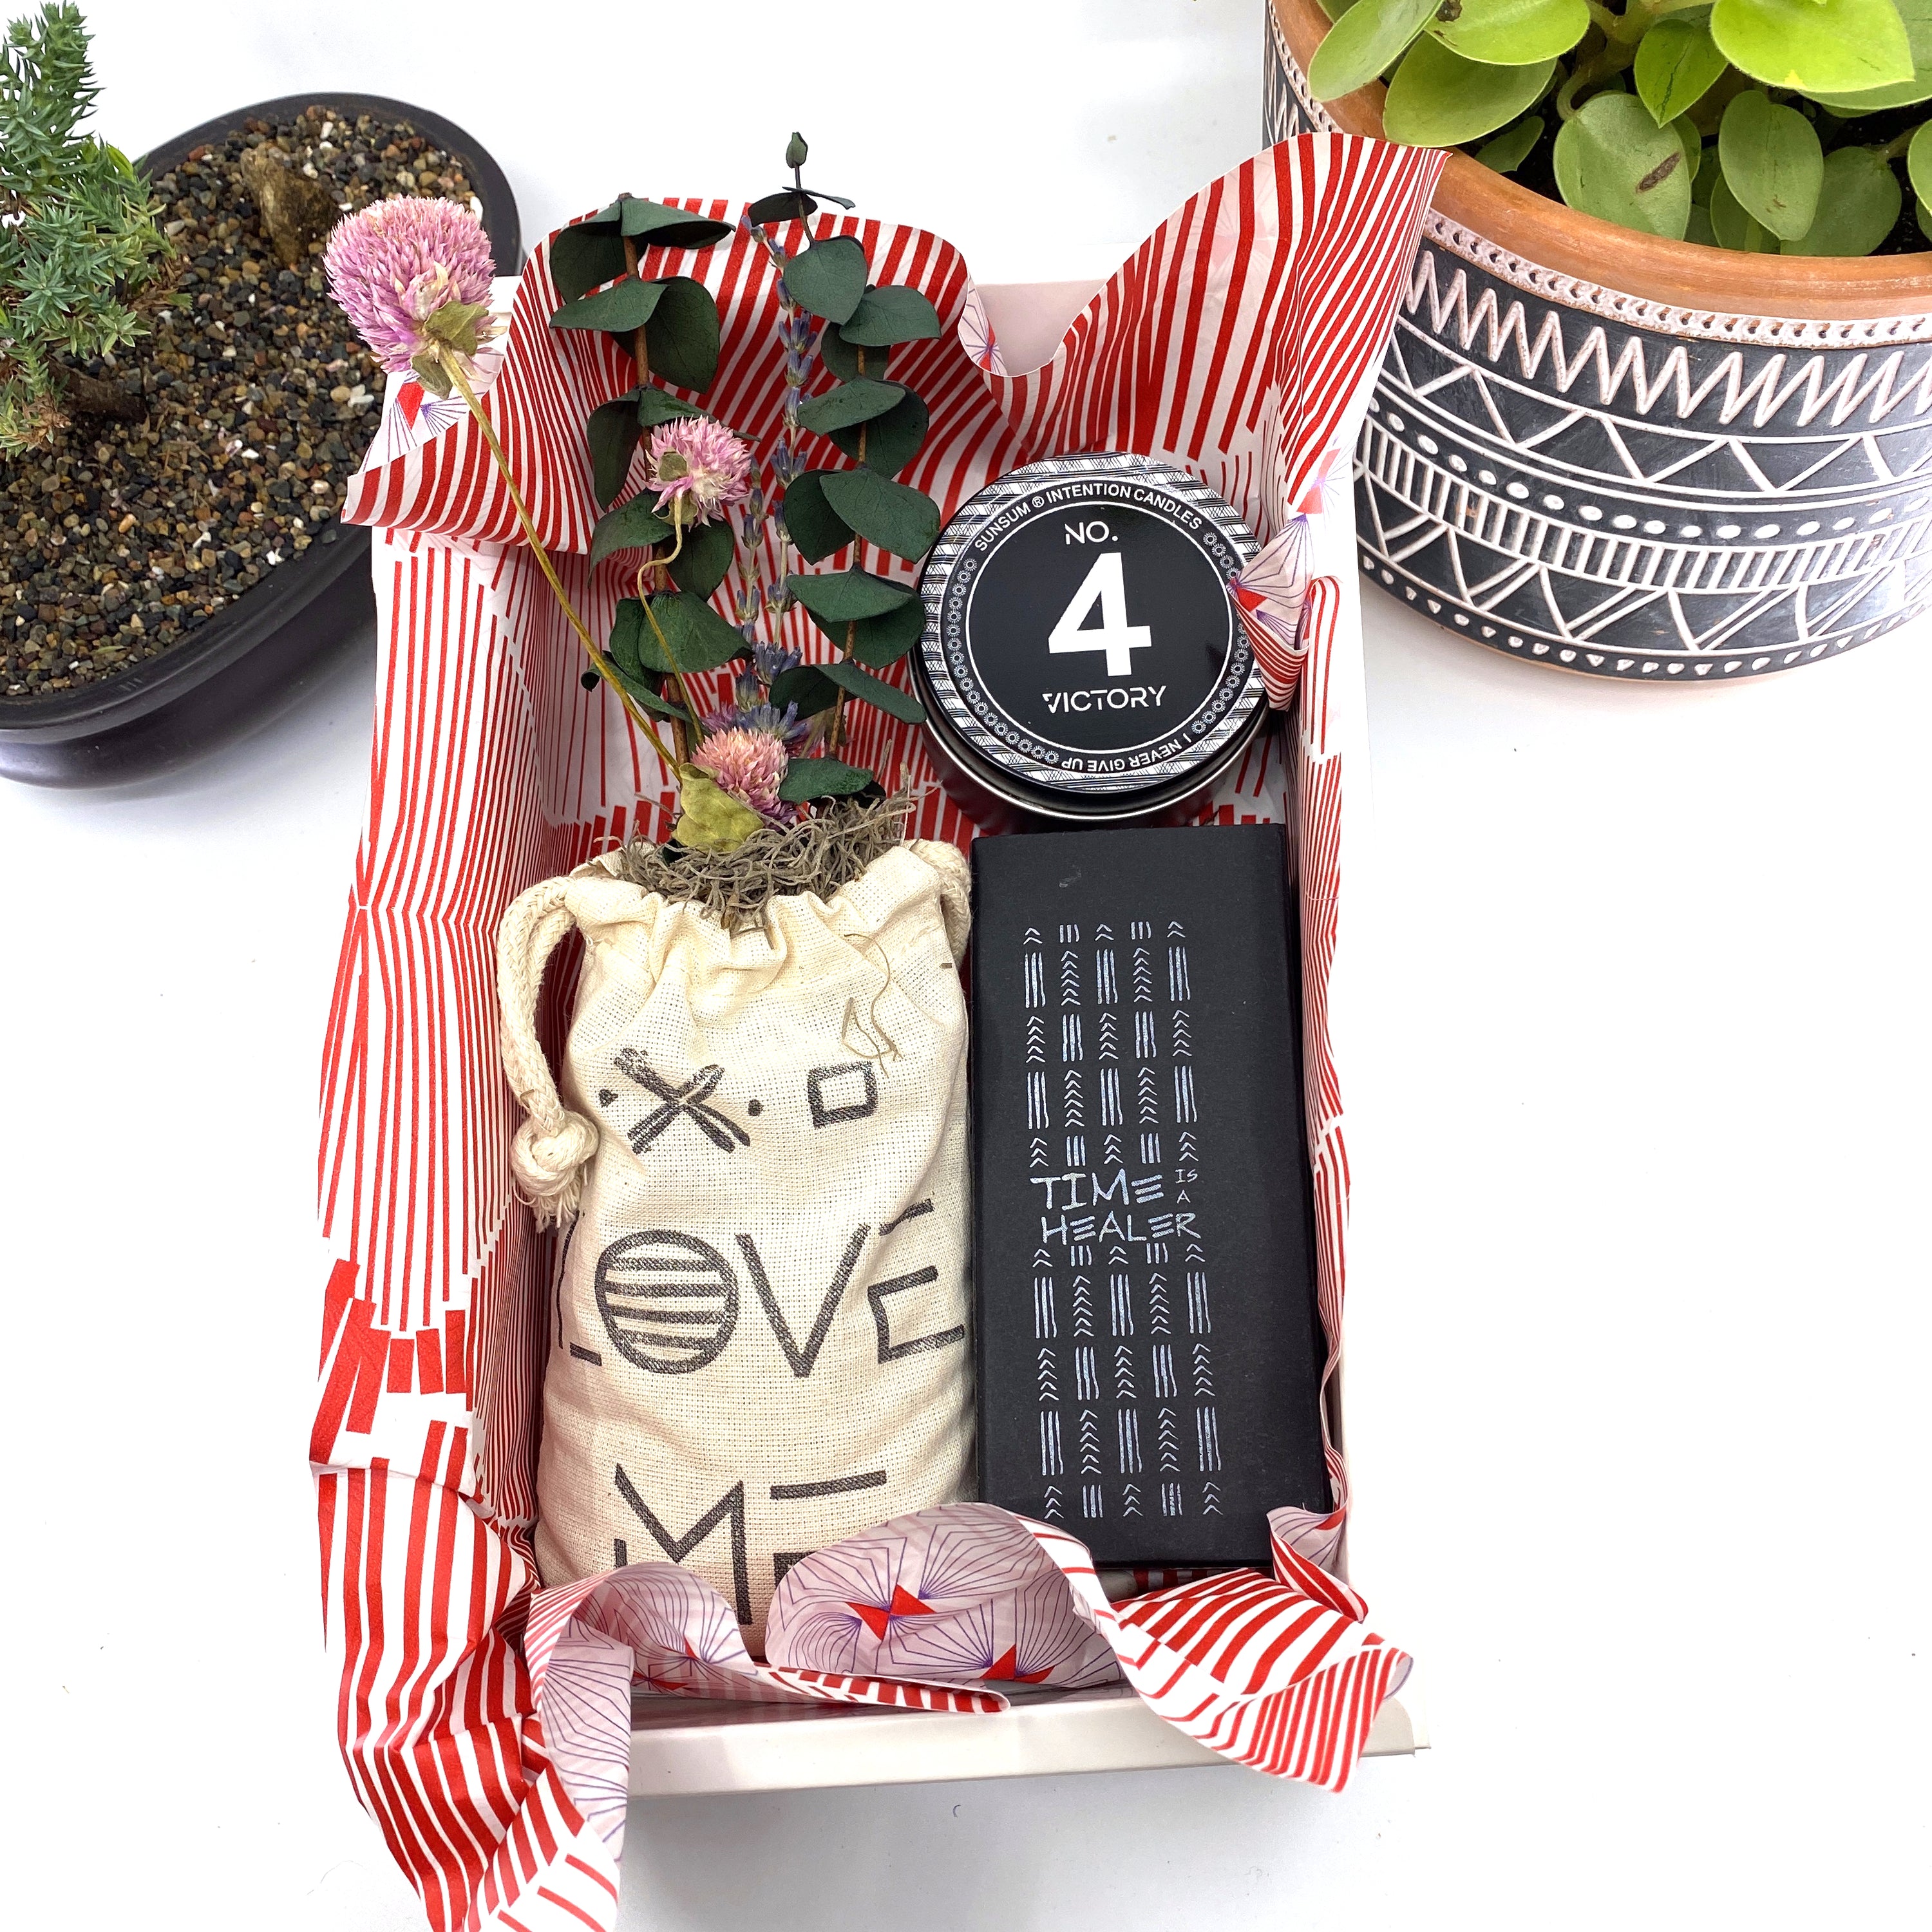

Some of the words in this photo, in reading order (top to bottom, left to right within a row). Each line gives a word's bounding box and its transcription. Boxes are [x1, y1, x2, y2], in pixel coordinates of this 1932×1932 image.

[974, 501, 1032, 553] SUNSUM
[1046, 483, 1131, 504] INTENTION
[1133, 488, 1203, 531] CANDLES
[1064, 520, 1119, 545] NO.
[1048, 551, 1152, 677] 4
[1041, 685, 1168, 714] VICTORY
[1182, 732, 1193, 743] I
[1061, 756, 1086, 770] UP
[1086, 758, 1126, 773] GIVE
[1128, 738, 1181, 769] NEVER
[1030, 1168, 1164, 1211] TIME
[1175, 1168, 1198, 1184] IS
[1176, 1189, 1191, 1204] A
[1041, 1210, 1202, 1245] HEALER
[554, 1198, 966, 1378] LOVE
